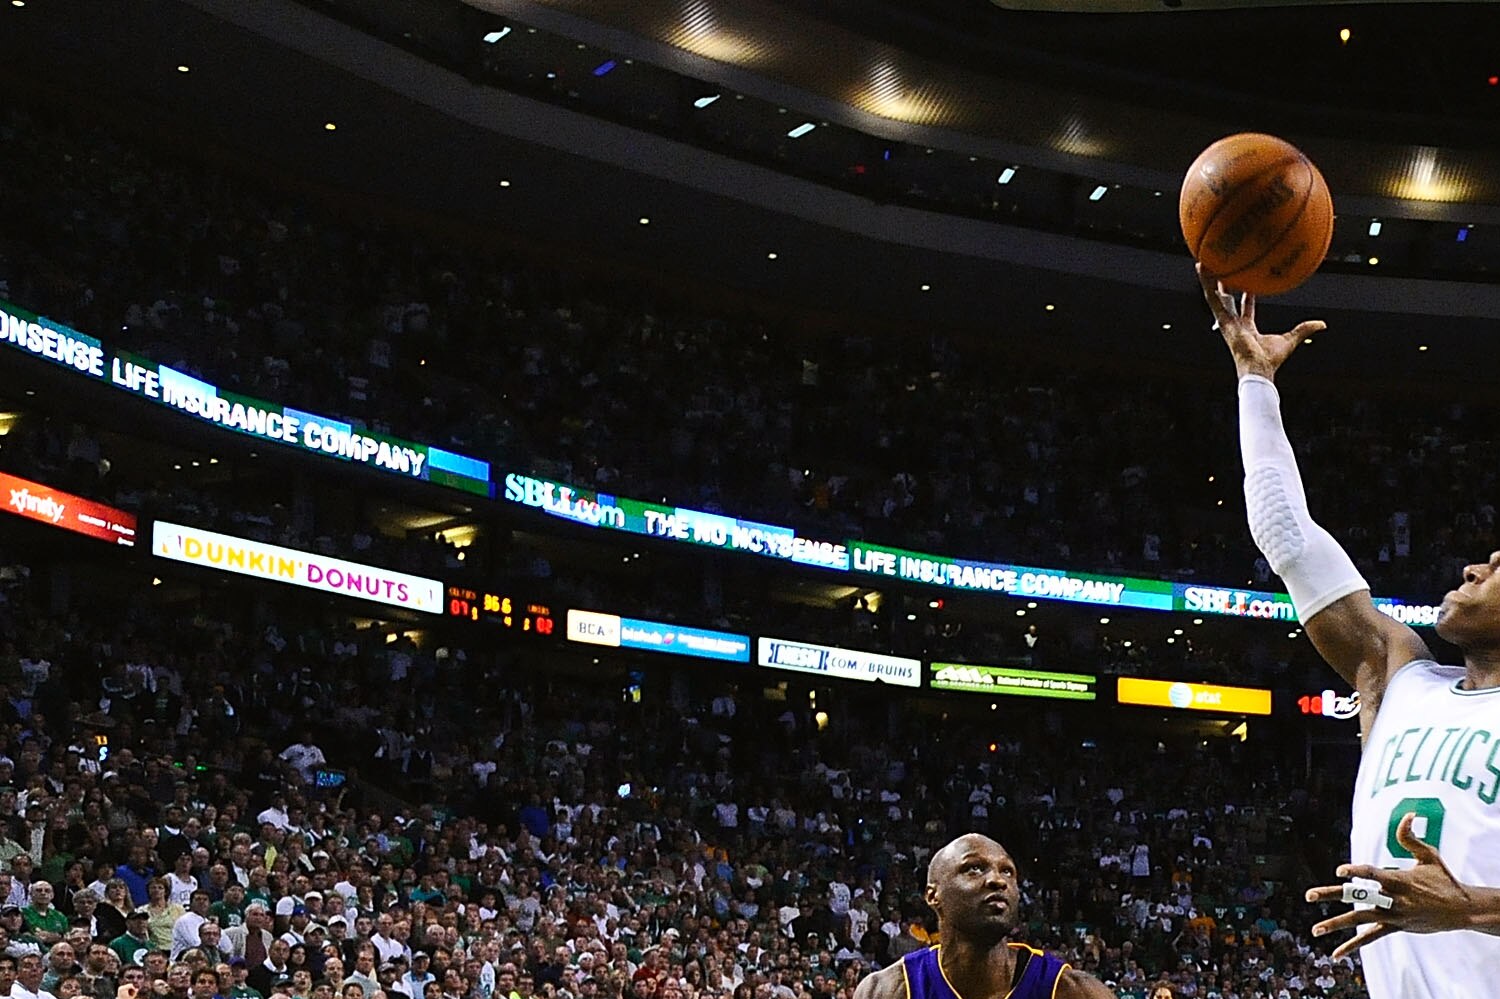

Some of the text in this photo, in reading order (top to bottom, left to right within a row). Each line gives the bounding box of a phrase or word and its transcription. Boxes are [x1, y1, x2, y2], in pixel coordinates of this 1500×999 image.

[112, 357, 160, 398] LIFE
[162, 380, 300, 444] INSURANCE
[303, 422, 426, 476] COMPANY
[184, 536, 409, 602] DUNKIN' DONUTS
[644, 510, 690, 539] THE
[693, 519, 728, 546] NO
[854, 548, 896, 576] LIFE
[900, 556, 1017, 591] INSURANCE
[1021, 572, 1125, 603] COMPANY
[578, 621, 606, 637] BCA
